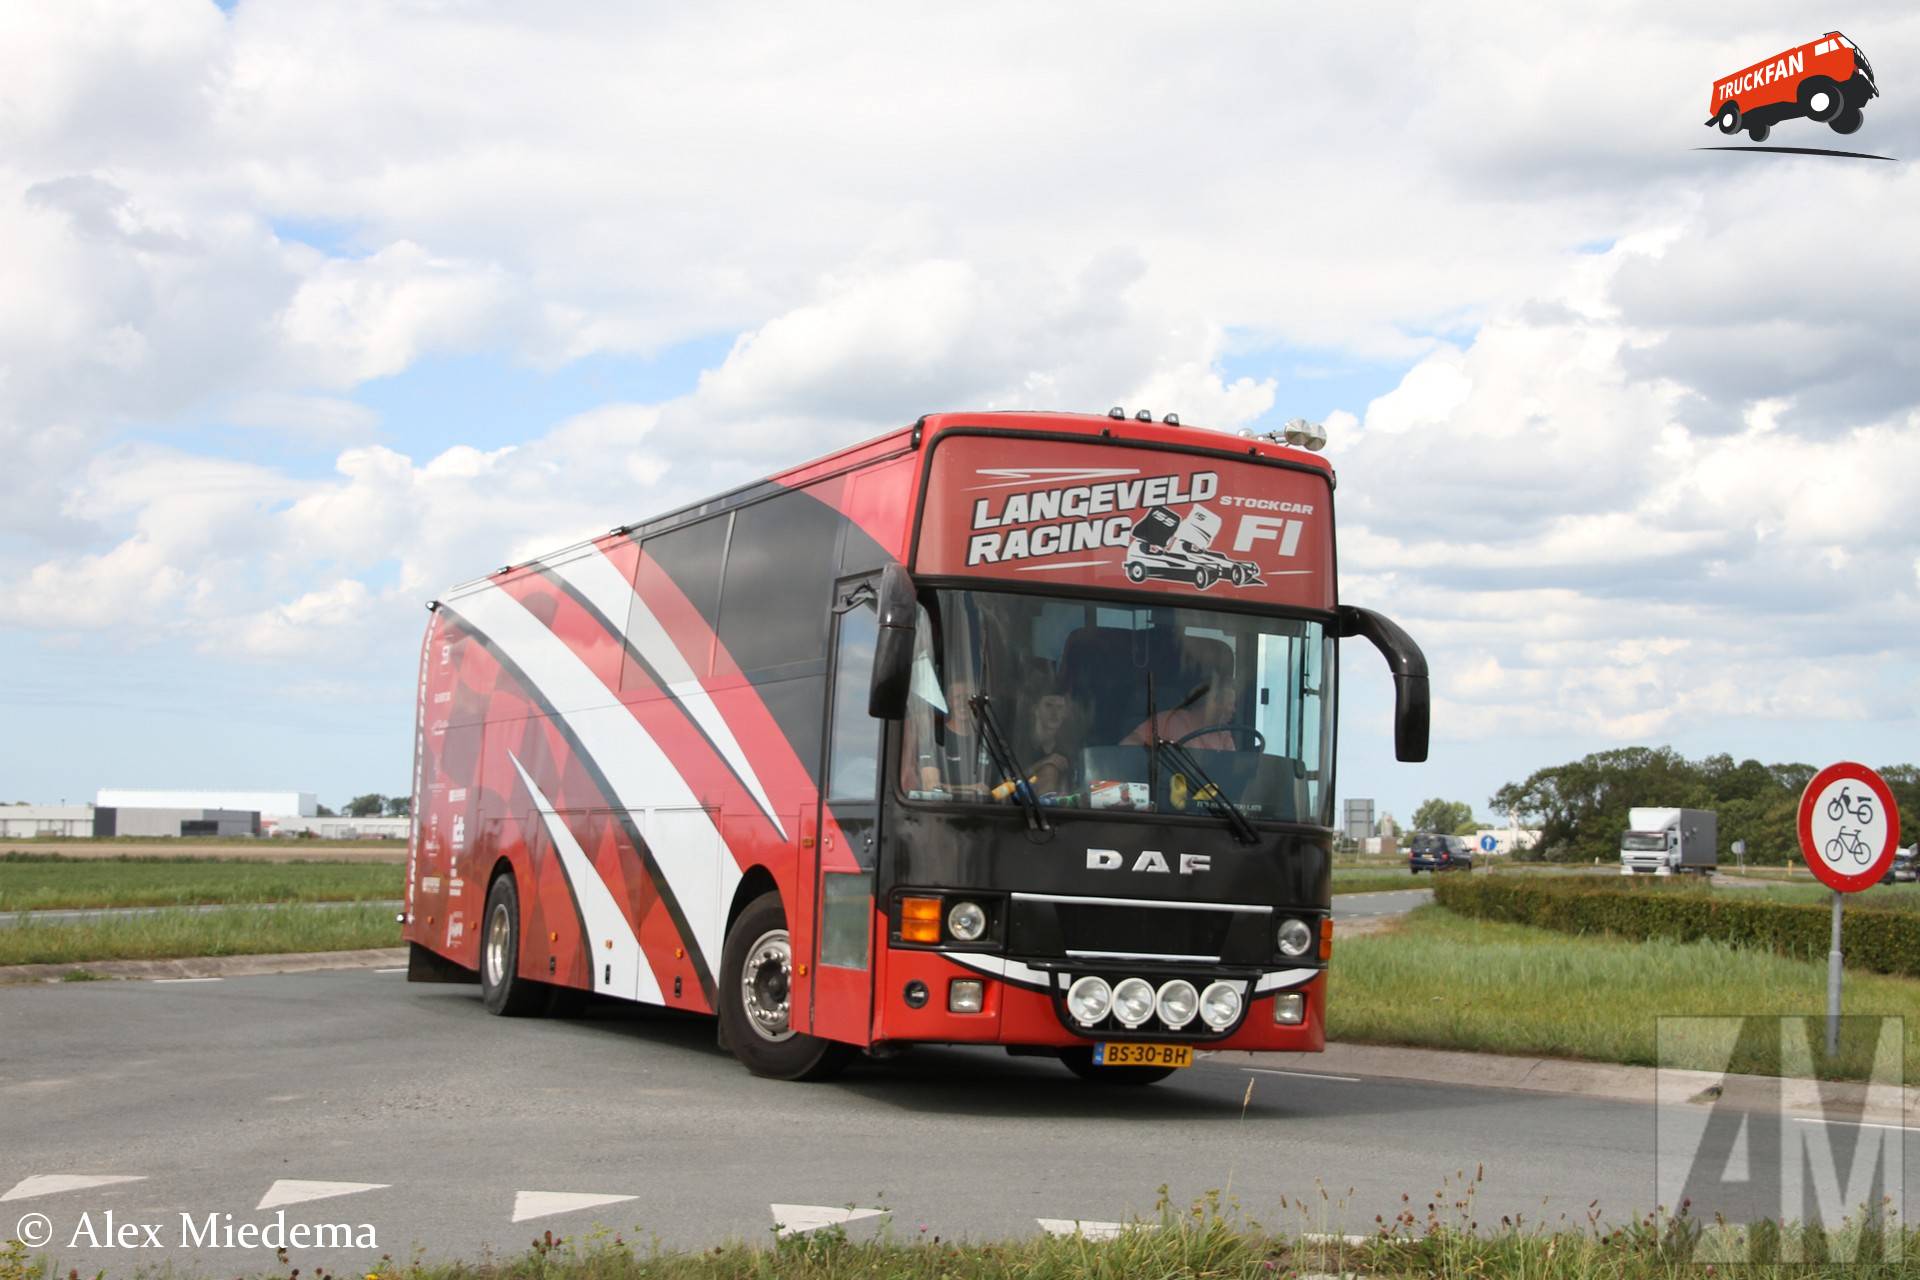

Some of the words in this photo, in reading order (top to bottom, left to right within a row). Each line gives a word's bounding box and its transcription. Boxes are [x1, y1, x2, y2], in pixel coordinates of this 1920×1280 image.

[973, 472, 1218, 529] LANGEVELD
[1219, 495, 1314, 515] STOCKCAR
[966, 516, 1132, 566] RACING
[1086, 849, 1211, 874] DAF
[1108, 1046, 1187, 1064] BS-30-BH
